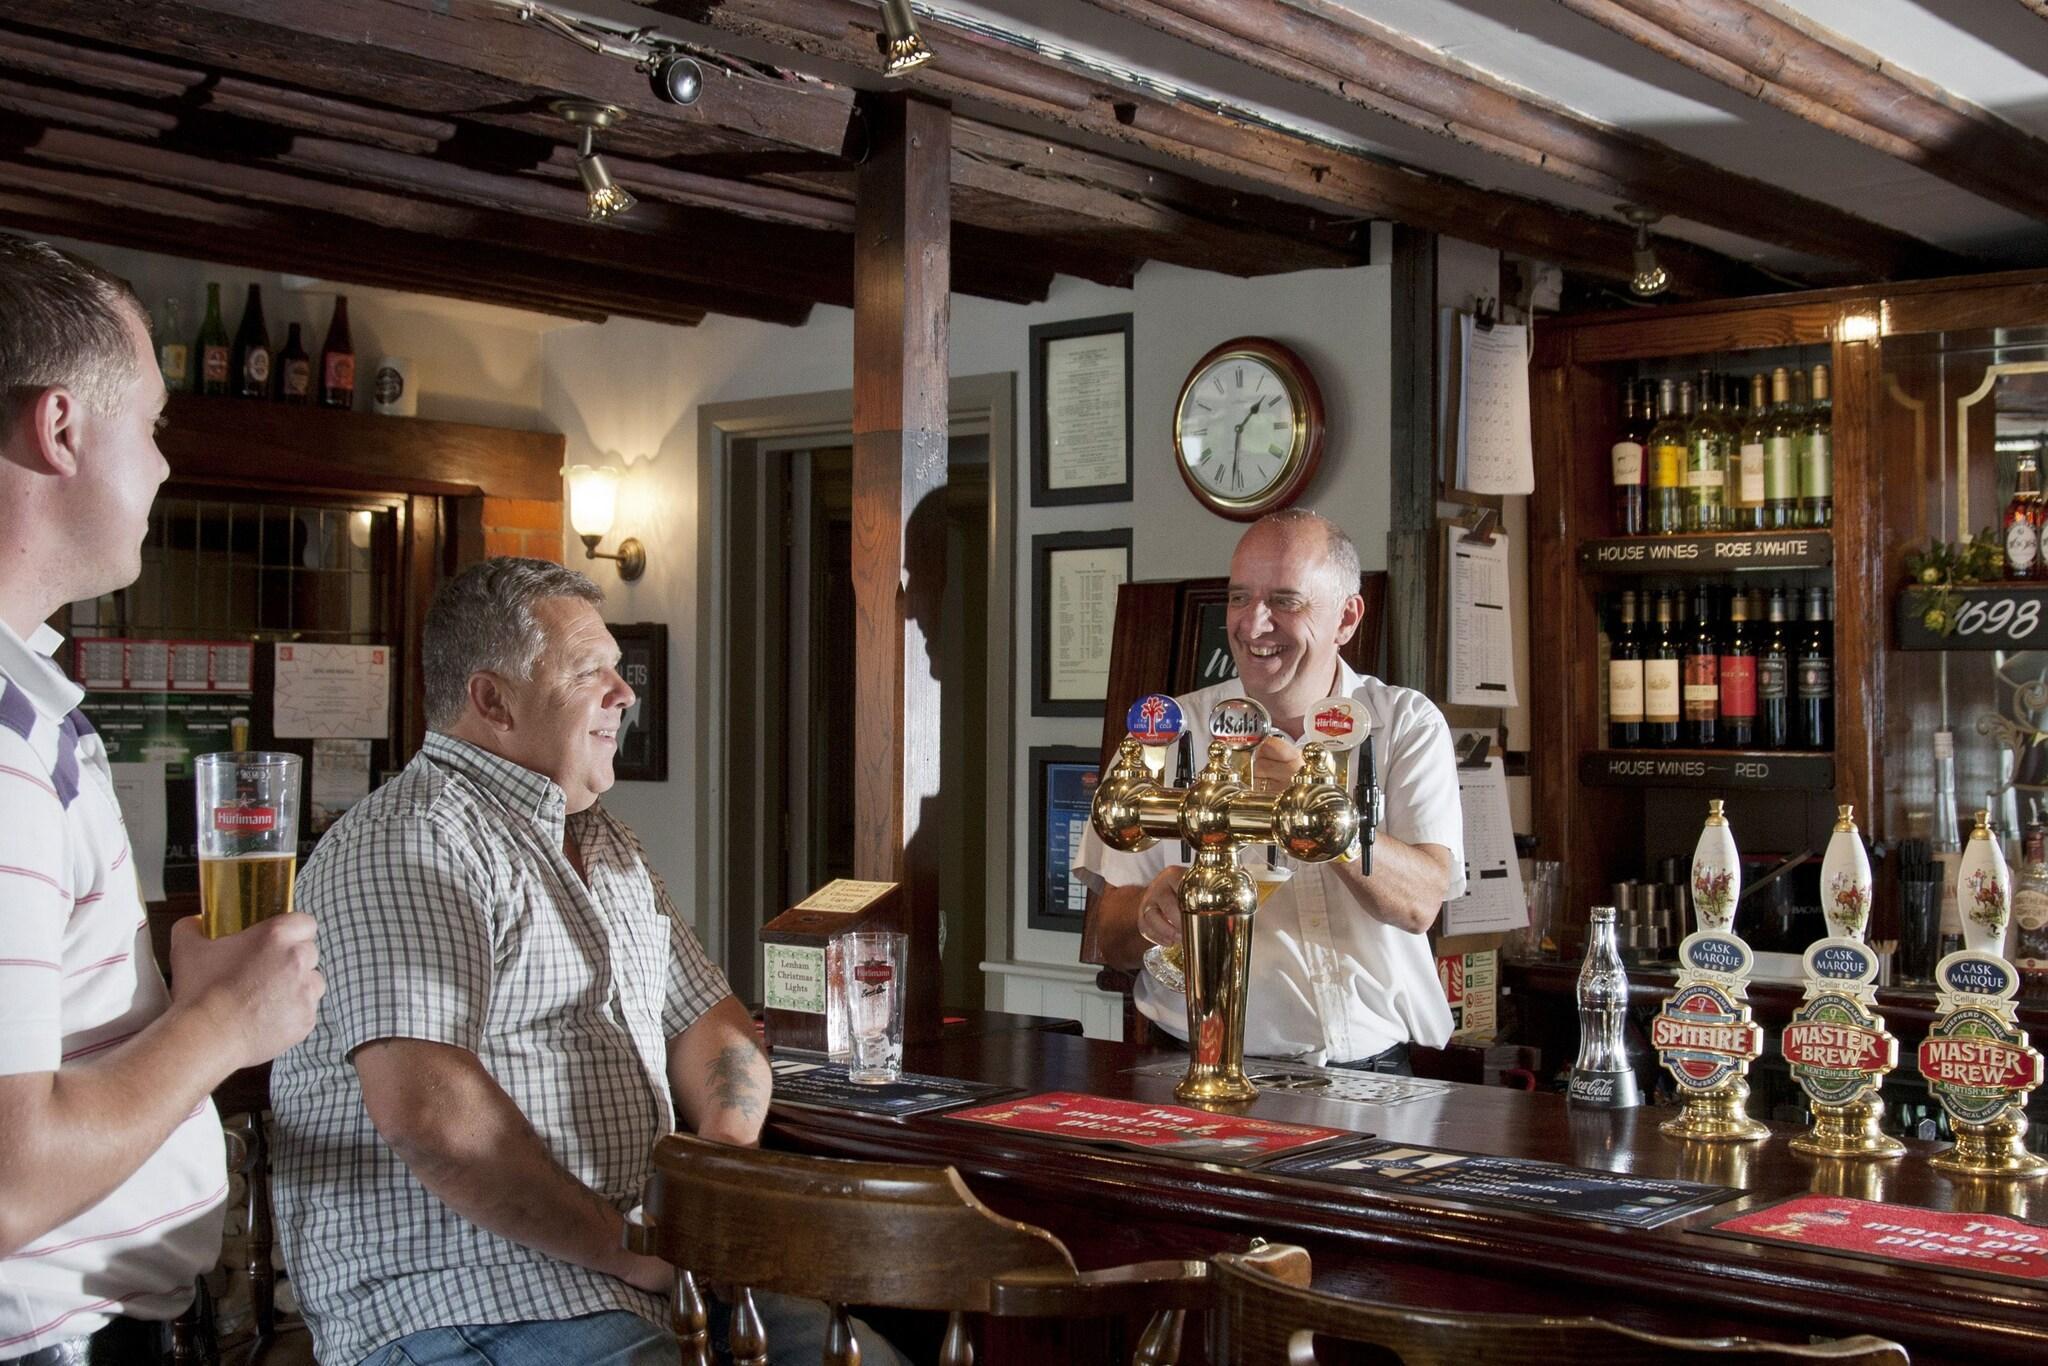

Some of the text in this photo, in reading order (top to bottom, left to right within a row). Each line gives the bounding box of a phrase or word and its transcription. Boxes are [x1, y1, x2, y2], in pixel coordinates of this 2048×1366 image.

[1598, 546, 1645, 561] HOUSE
[1650, 544, 1699, 560] WINES
[1715, 542, 1752, 557] ROSE
[1763, 540, 1808, 556] WHITE
[1213, 710, 1257, 734] Asahi
[1609, 761, 1769, 778] HOUSE WINES RED
[217, 812, 272, 825] Hürlimann
[1702, 941, 1730, 954] CASK
[1825, 949, 1854, 960] CASK
[781, 959, 810, 970] Lenham
[1693, 951, 1740, 966] MARQUE
[1816, 960, 1864, 972] MARQUE
[1960, 962, 1992, 975] CASK
[785, 982, 808, 994] Lights
[1951, 973, 2004, 987] MARQUE
[1806, 997, 1839, 1019] SHEPHERD
[1954, 994, 2000, 1006] Cellar Cool
[1943, 1011, 2006, 1039] SHEPHERD NEAME
[1656, 1020, 1747, 1052] SPITFIRE
[1791, 1026, 1880, 1058] MASTER
[1801, 1045, 1862, 1067] BREW
[1929, 1043, 2027, 1075] MASTER
[1804, 1066, 1855, 1078] KENTISH ALE
[1941, 1062, 2006, 1085] BREW
[1943, 1081, 1999, 1096] KENTISH ALE
[1063, 1110, 1139, 1124] more
[1140, 1109, 1194, 1123] Two
[1958, 1106, 1981, 1119] LOCAL
[1982, 1102, 2001, 1117] HERO
[1427, 1182, 1559, 1204] Appearance
[1440, 1178, 1511, 1191] Aroma
[1456, 1174, 1583, 1195] Temperature
[1862, 1222, 1973, 1243] more
[1963, 1221, 2040, 1242] Two
[1875, 1235, 2030, 1265] please.
